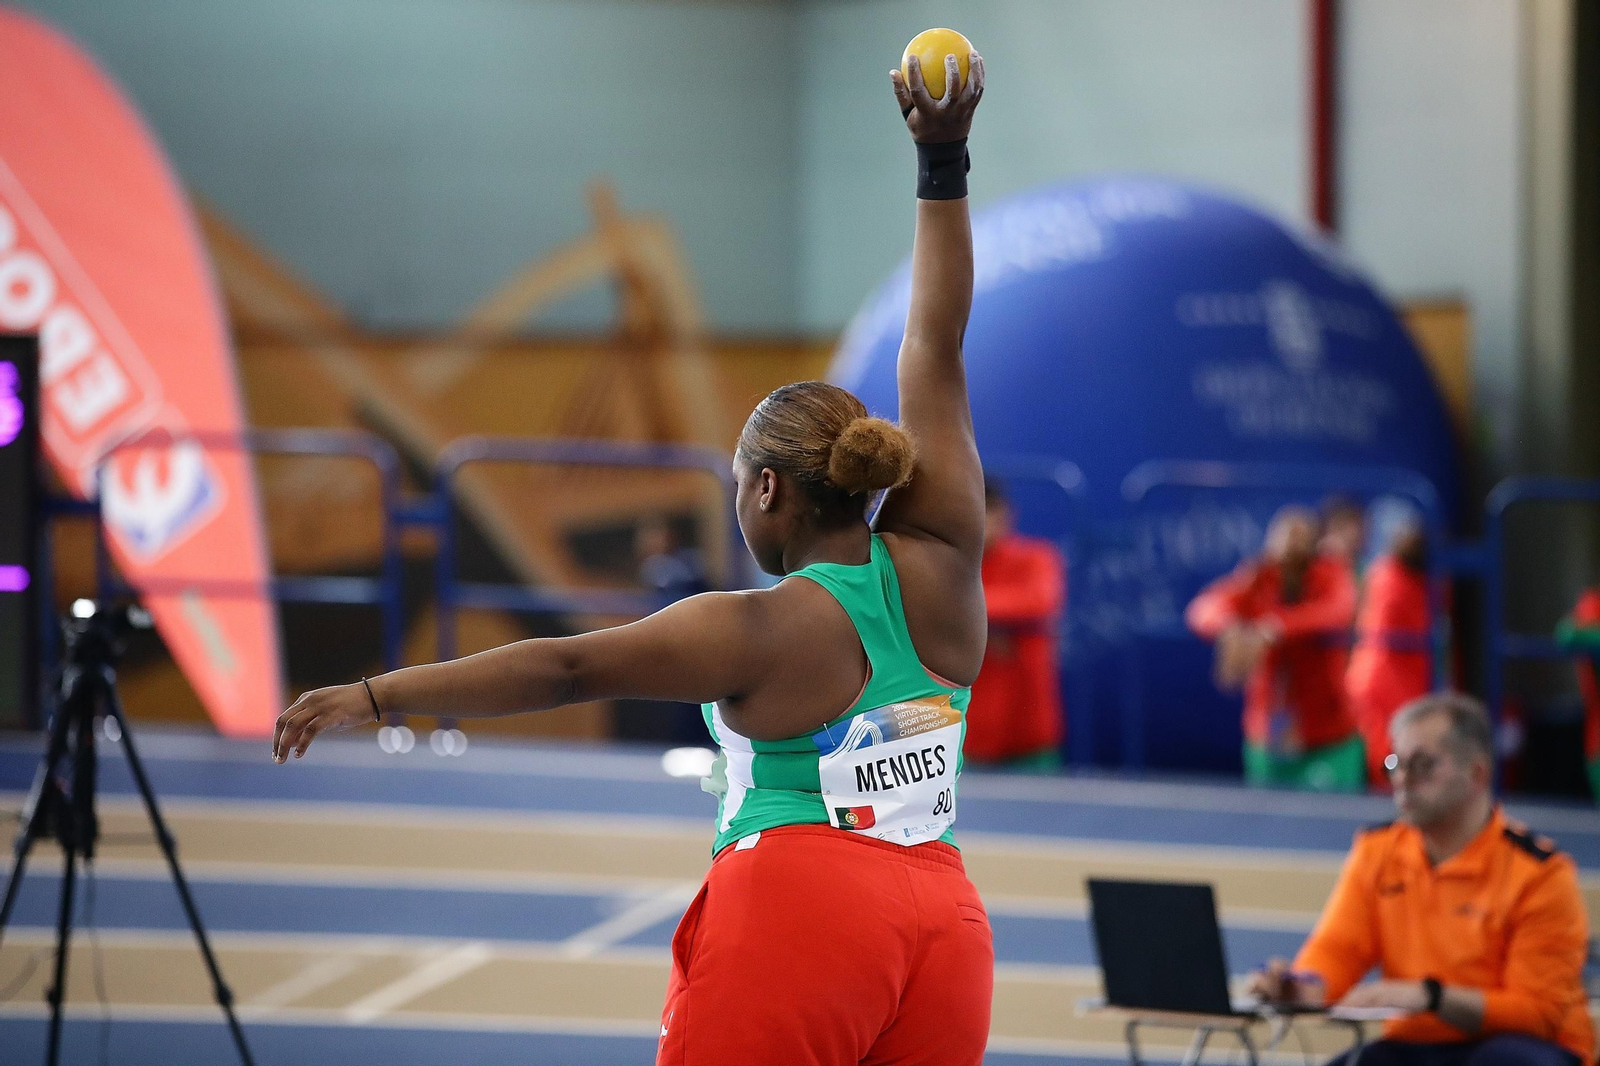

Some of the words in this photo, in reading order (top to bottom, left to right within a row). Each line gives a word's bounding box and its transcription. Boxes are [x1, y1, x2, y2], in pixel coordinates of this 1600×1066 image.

[895, 708, 918, 720] VIRTUS
[898, 716, 920, 729] SHORT
[920, 711, 941, 723] TRACK
[899, 717, 949, 737] CHAMPIONSHIP
[855, 744, 946, 792] MENDES
[932, 787, 953, 816] 80
